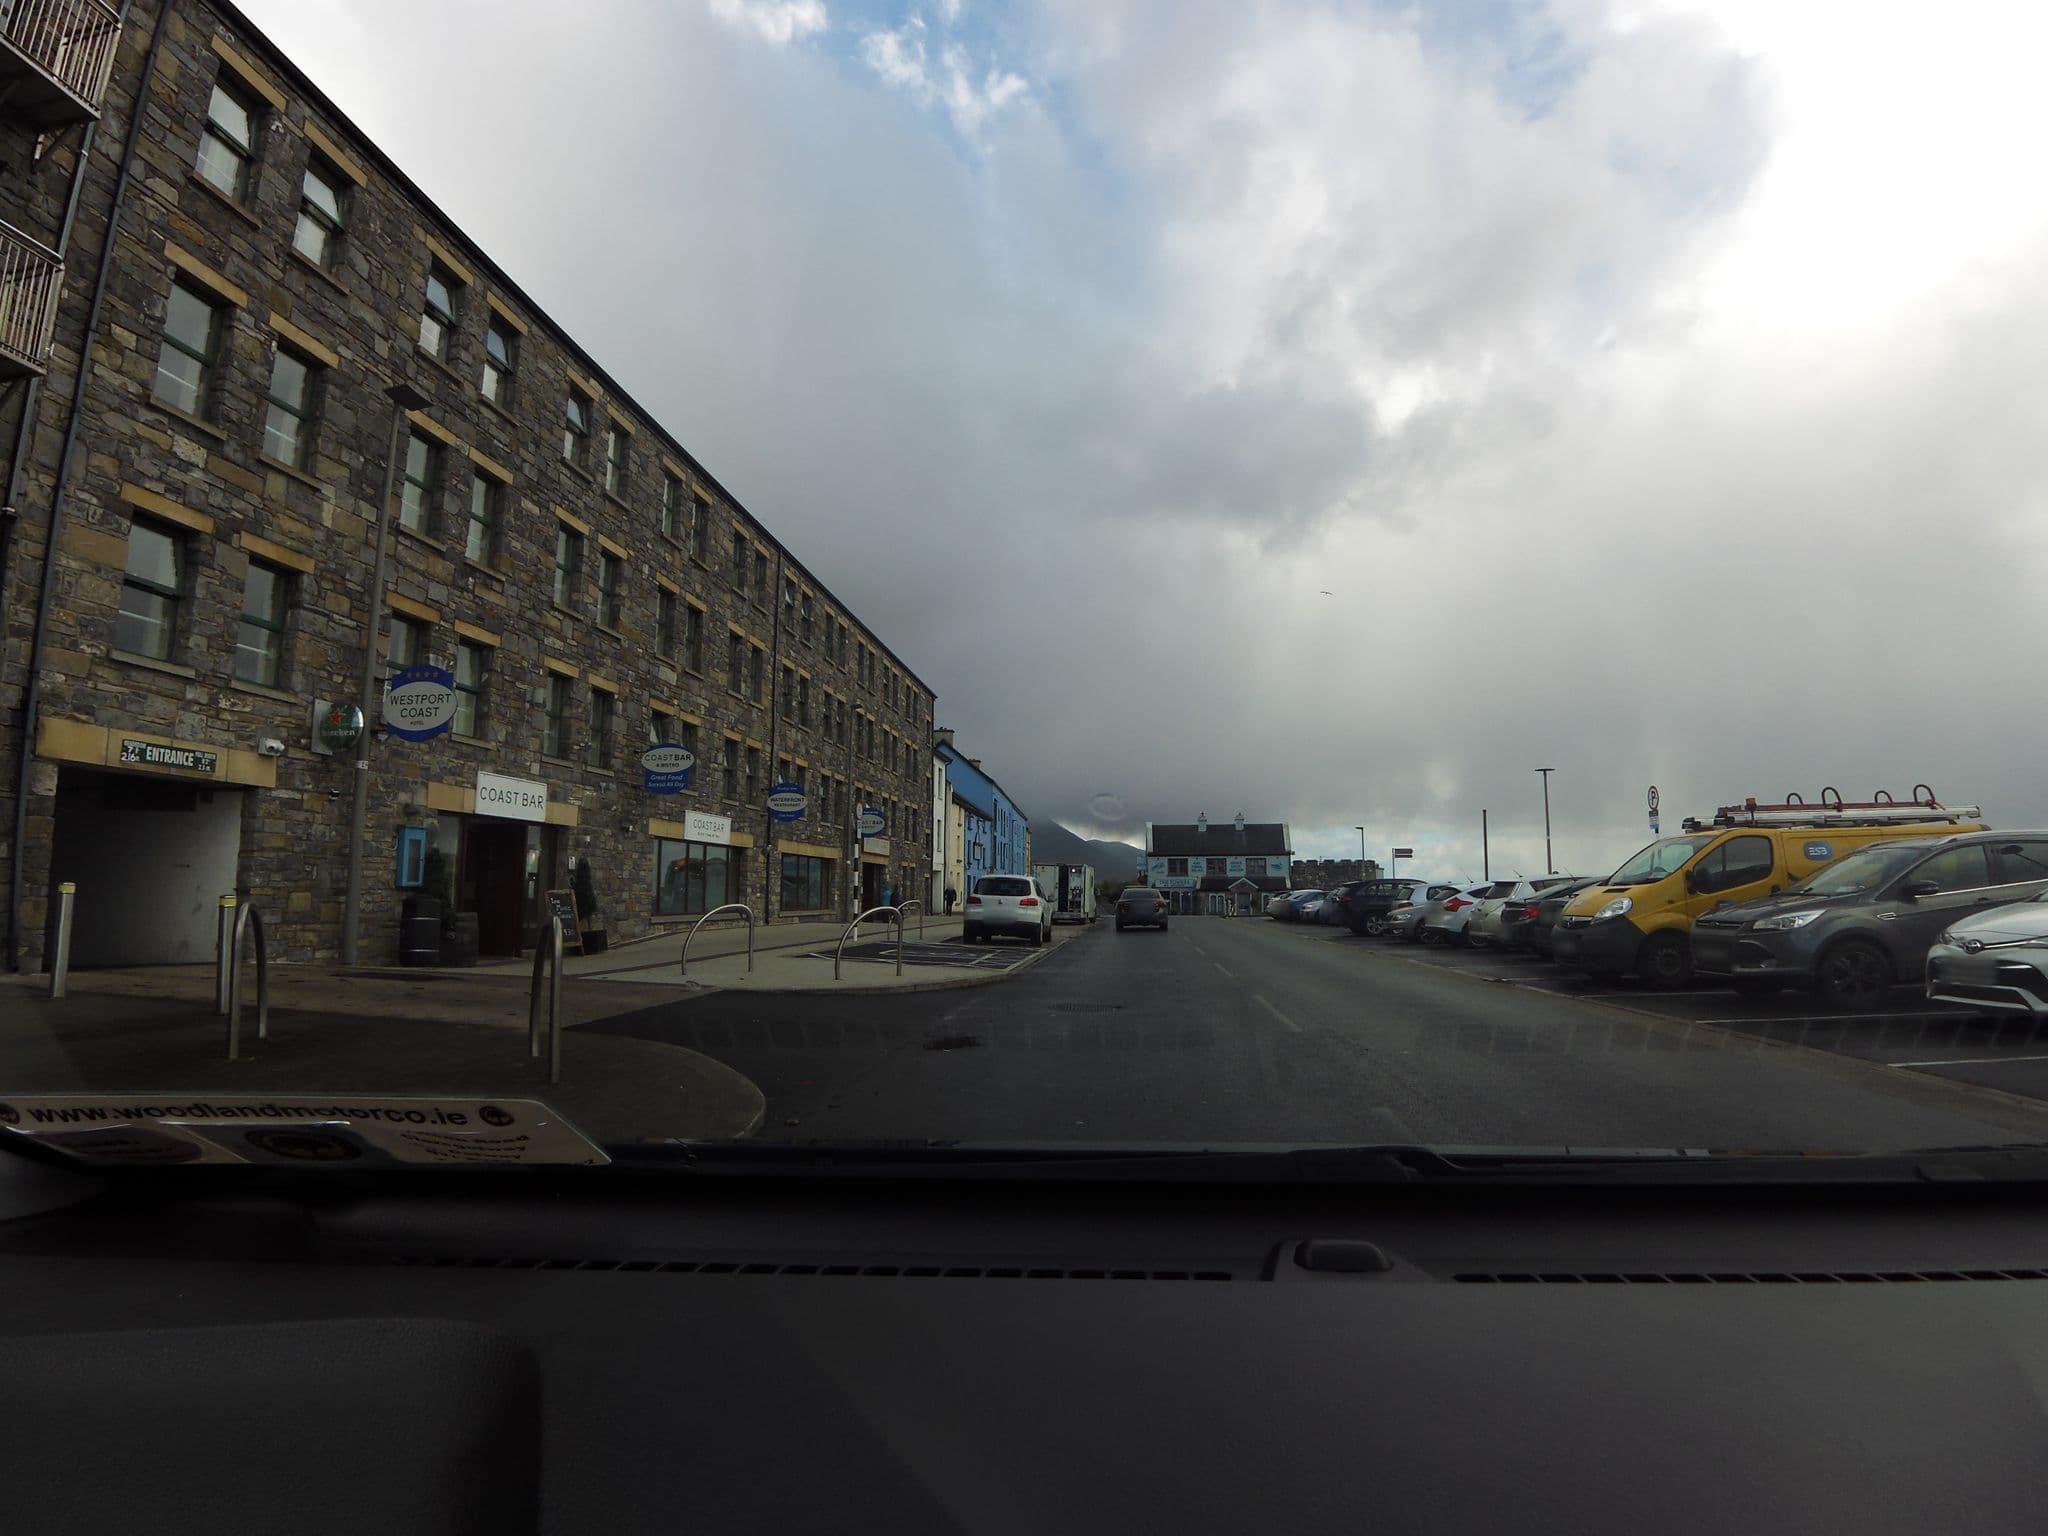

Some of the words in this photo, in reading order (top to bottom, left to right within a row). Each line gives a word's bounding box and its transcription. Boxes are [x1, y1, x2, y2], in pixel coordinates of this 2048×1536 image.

[390, 693, 451, 705] WESTPORT
[400, 707, 439, 718] COAST
[145, 746, 194, 767] ENTRANCE
[674, 753, 691, 761] BAR
[480, 786, 519, 806] COAST
[522, 793, 544, 809] BAR
[693, 818, 713, 831] COAST
[713, 821, 725, 832] BAR
[1807, 846, 1828, 856] ESB
[27, 1103, 467, 1126] www.woodlandmotorco.ie
